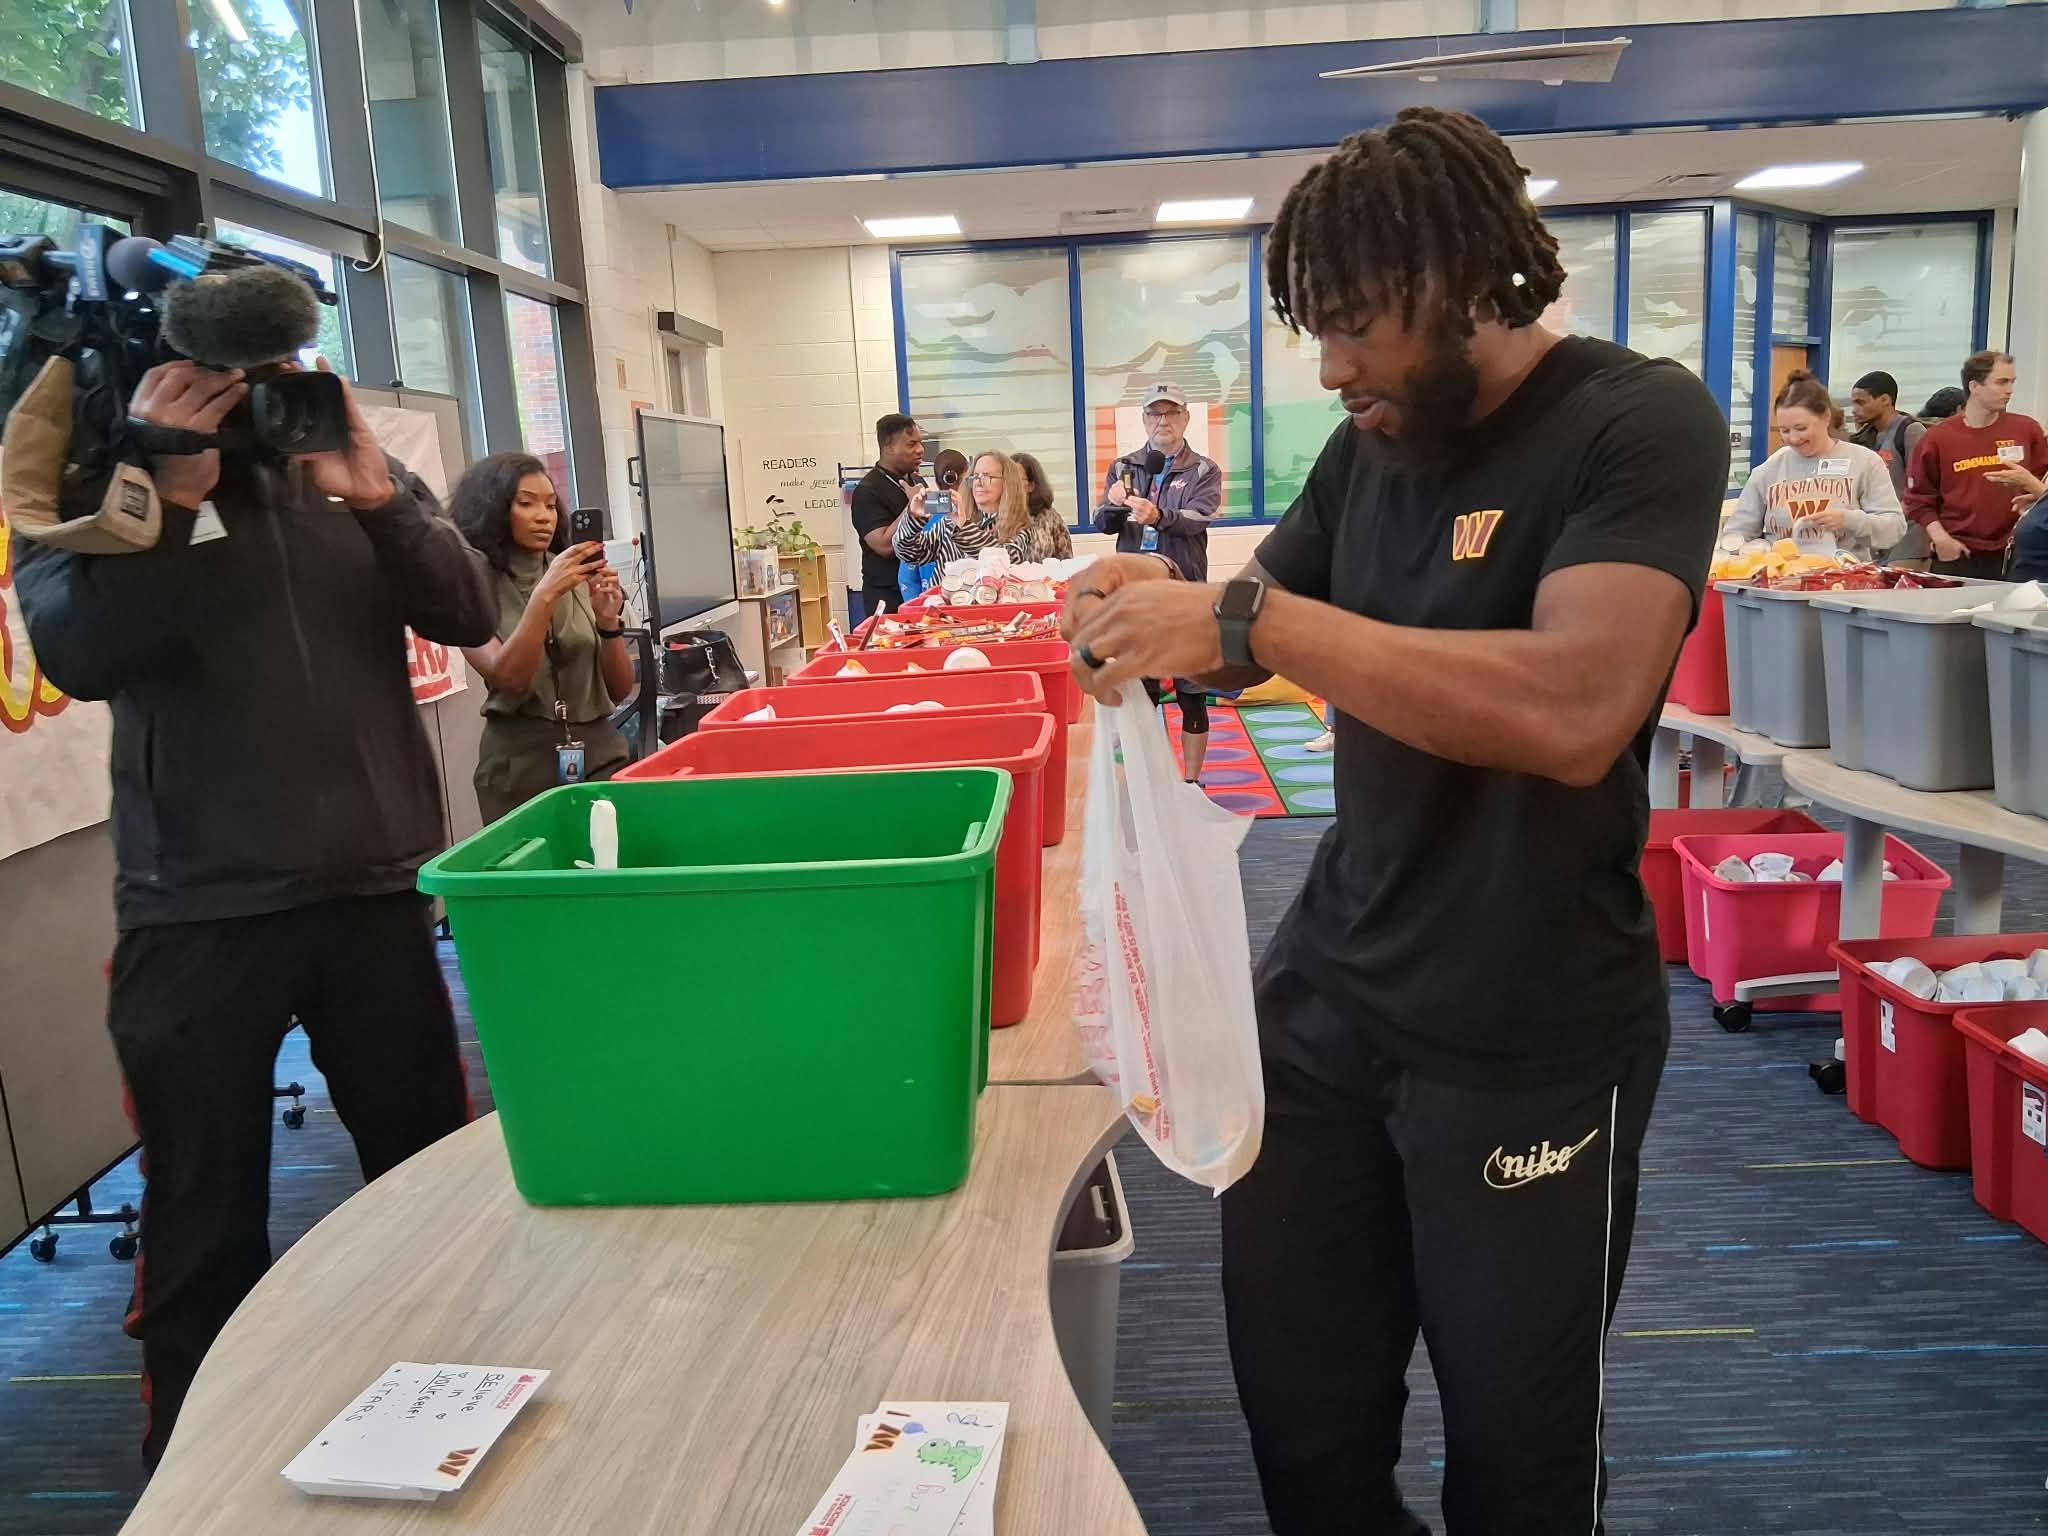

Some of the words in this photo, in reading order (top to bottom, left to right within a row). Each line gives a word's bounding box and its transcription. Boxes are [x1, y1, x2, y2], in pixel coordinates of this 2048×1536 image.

[763, 457, 817, 470] READERS
[1953, 455, 2001, 472] COMMAN
[780, 477, 806, 487] make
[810, 477, 837, 489] great
[1768, 477, 1853, 511] WASHINGTON
[804, 499, 841, 509] LEADE
[1453, 510, 1504, 560] W
